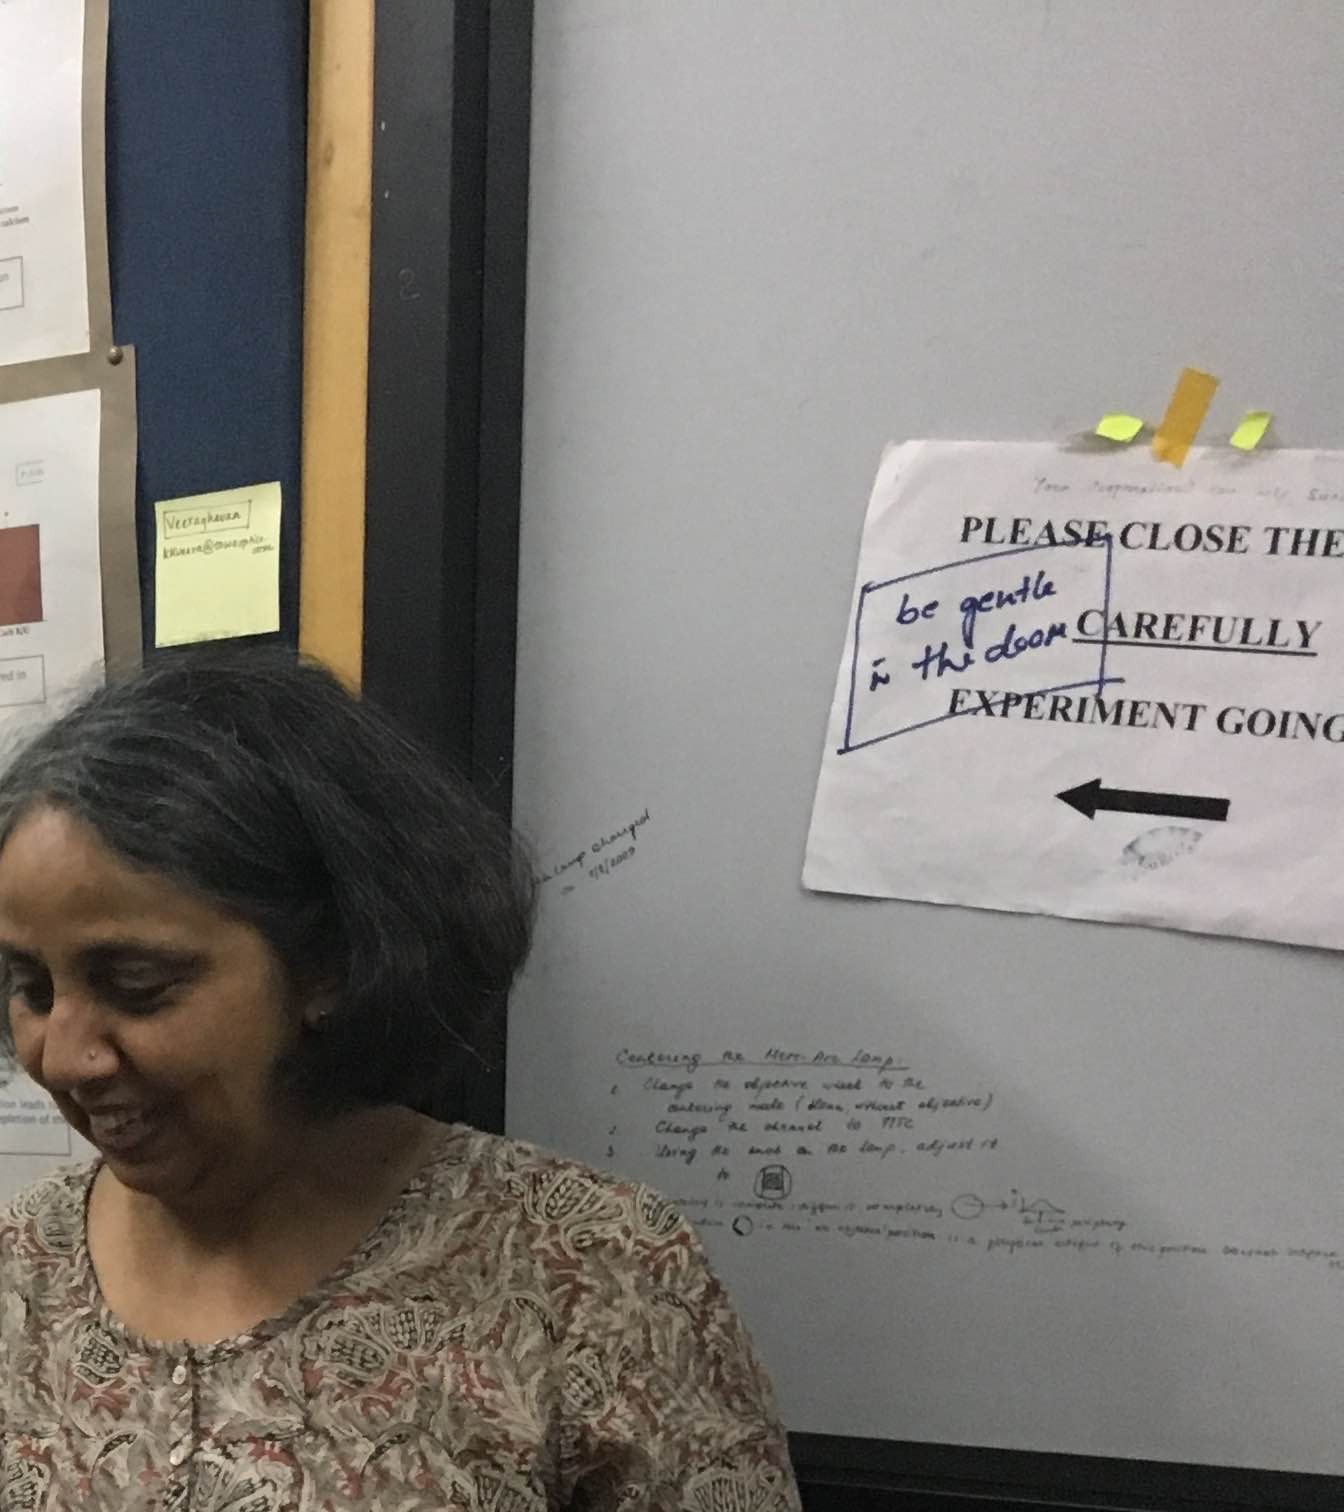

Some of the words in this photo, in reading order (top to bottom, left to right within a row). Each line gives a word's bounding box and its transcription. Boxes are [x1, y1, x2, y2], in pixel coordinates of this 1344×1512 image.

[960, 515, 1109, 549] PLEASE
[1119, 521, 1250, 555] CLOSE
[1264, 526, 1344, 559] THE
[896, 593, 939, 625] be
[960, 570, 1057, 648] gentle
[1077, 608, 1322, 651] CAREFULLY
[912, 642, 975, 681] the
[948, 688, 1207, 733] EXPERIMENT
[1217, 706, 1344, 744] GOING
